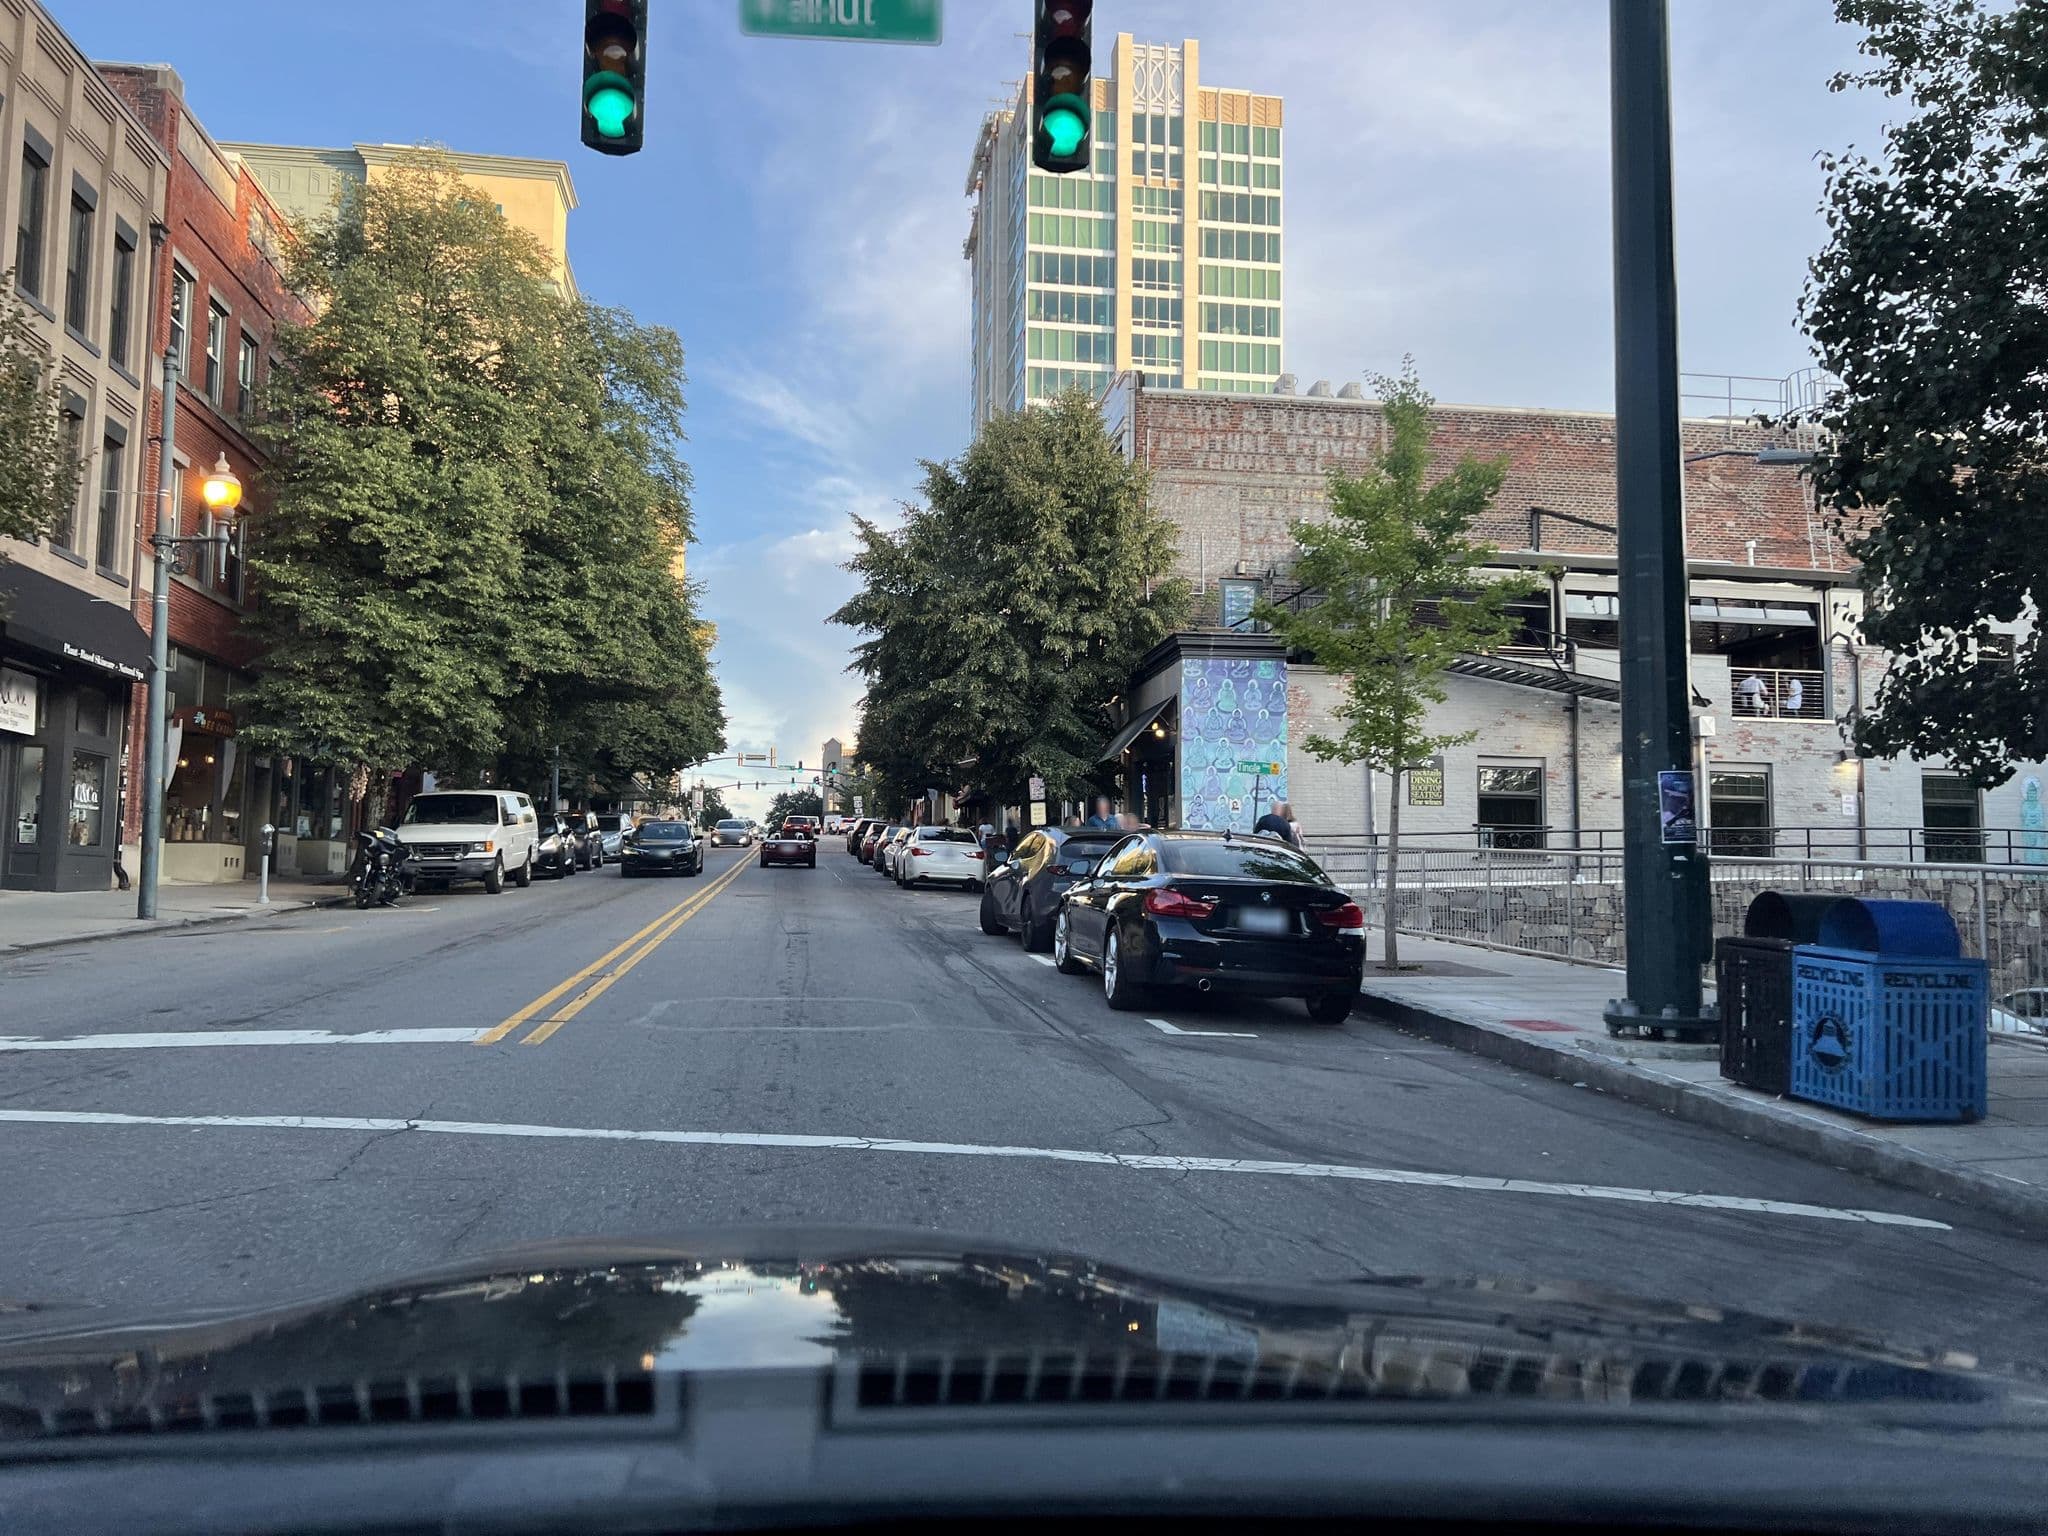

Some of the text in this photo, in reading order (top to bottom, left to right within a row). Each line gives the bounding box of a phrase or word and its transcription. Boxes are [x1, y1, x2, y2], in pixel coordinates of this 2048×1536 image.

[1411, 776, 1442, 785] DINING
[1411, 791, 1442, 799] SEATING
[1797, 963, 1865, 988] RECYCLING
[1883, 972, 1975, 990] RECYCLING
